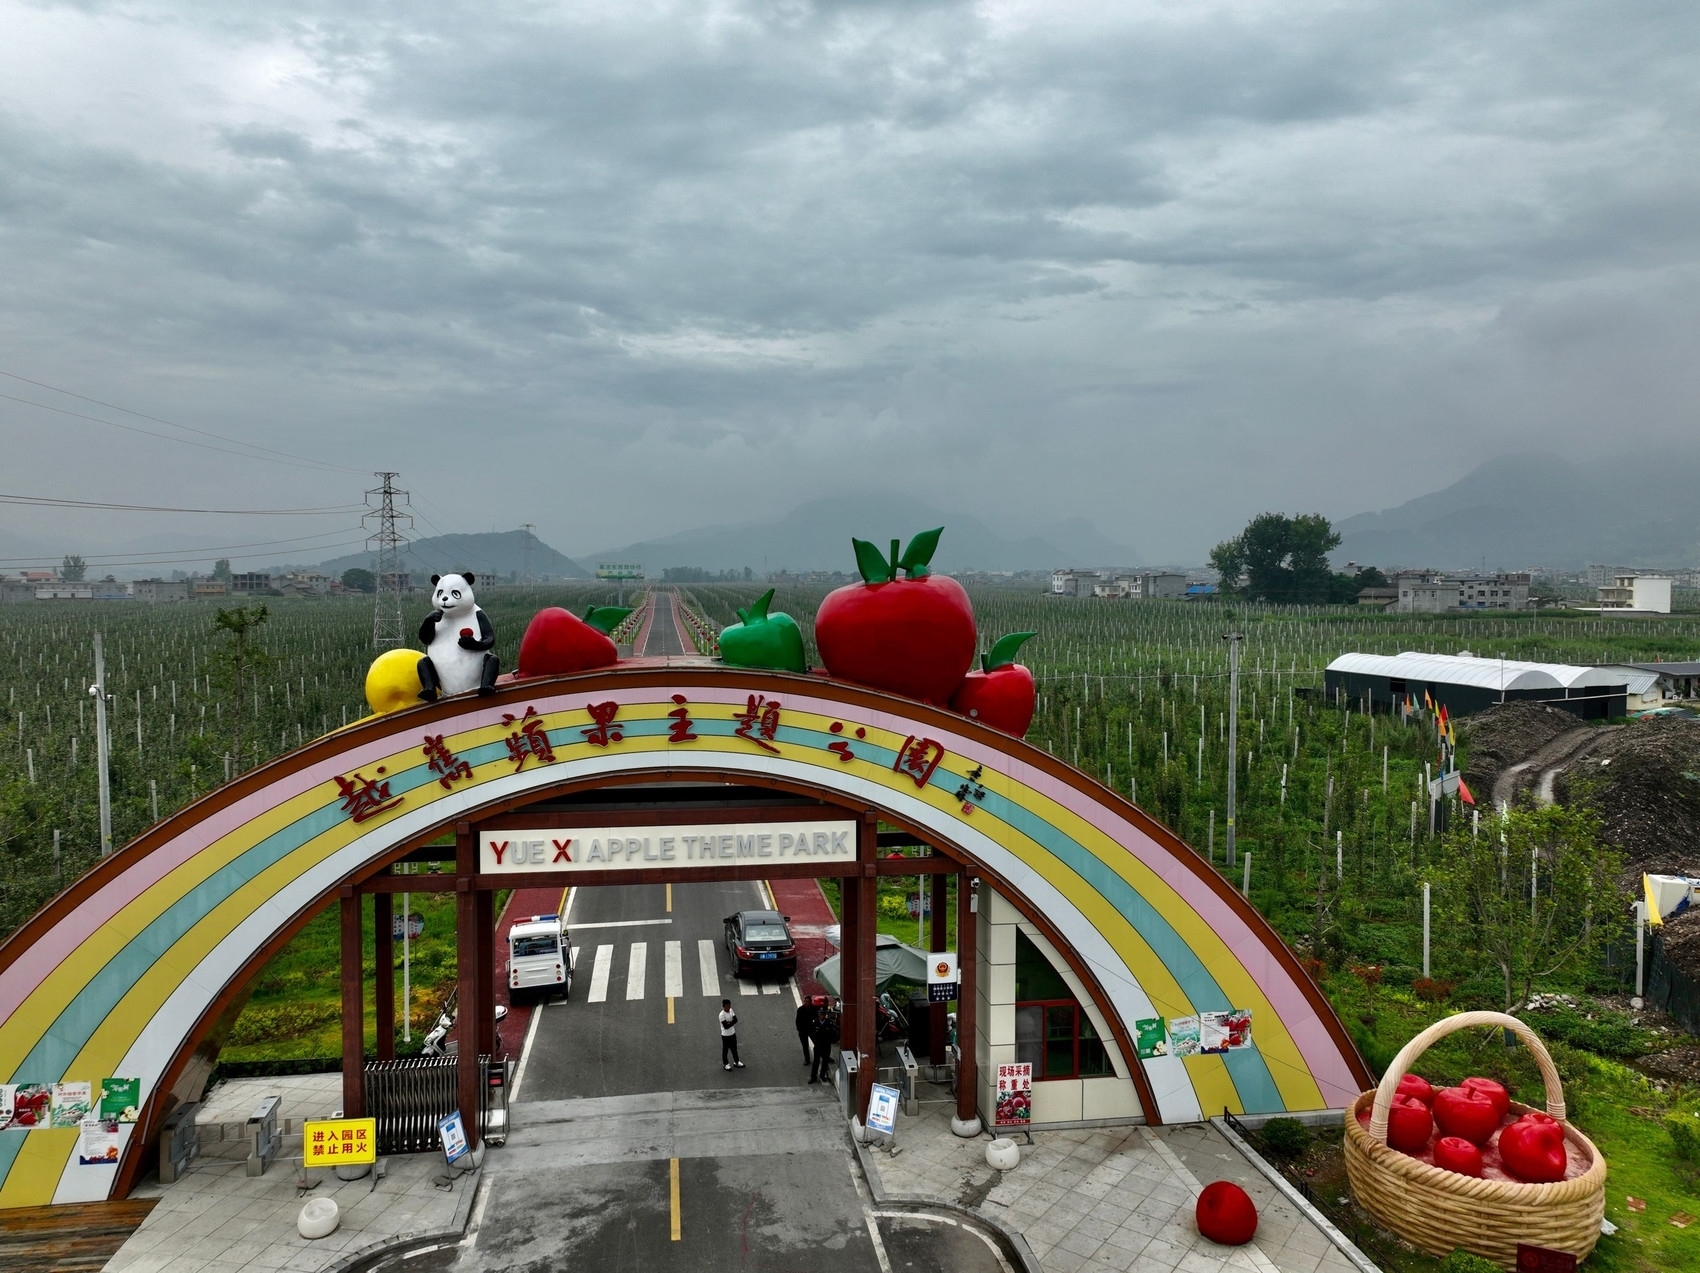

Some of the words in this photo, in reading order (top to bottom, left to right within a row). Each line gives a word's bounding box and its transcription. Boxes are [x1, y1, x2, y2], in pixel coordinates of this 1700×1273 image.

[490, 840, 544, 865] YUE
[552, 839, 580, 863] XI
[586, 836, 675, 862] APPLE
[682, 834, 772, 859] THEME
[778, 831, 849, 856] PARK
[999, 1064, 1031, 1078] 现场采摘
[999, 1078, 1030, 1091] 称重处
[312, 1129, 367, 1143] 进入园区
[312, 1142, 367, 1156] 禁止用火
